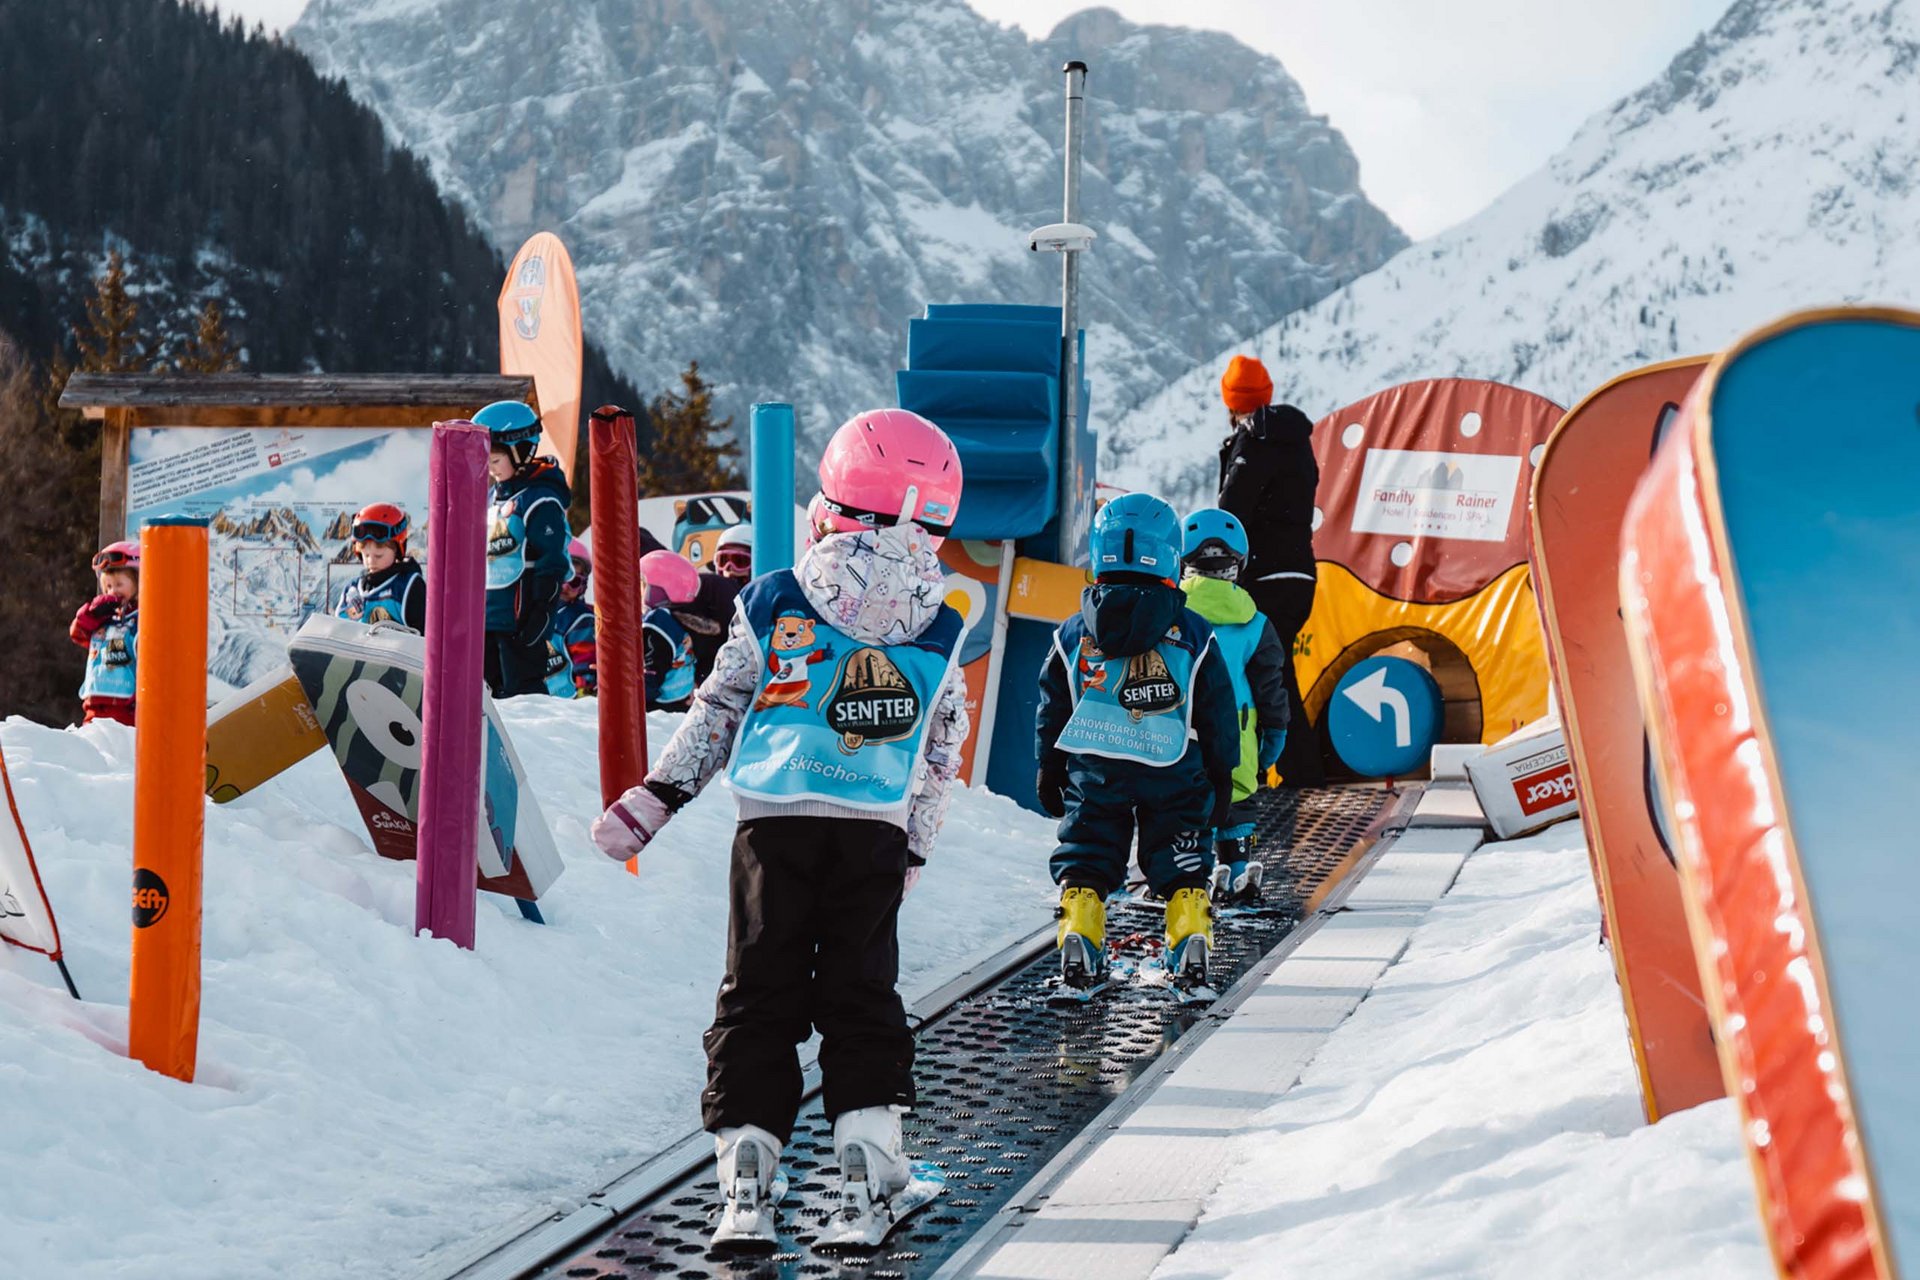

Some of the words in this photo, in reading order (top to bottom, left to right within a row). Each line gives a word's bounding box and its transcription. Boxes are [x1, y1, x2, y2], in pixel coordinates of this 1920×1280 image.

[1456, 492, 1498, 508] Rainer
[1123, 682, 1176, 702] SENFTER
[835, 697, 914, 725] SENFTER
[1062, 727, 1105, 743] SEXTNER
[1107, 734, 1165, 755] DOLOMITEN
[1073, 716, 1137, 737] SNOWBOARD
[1139, 730, 1175, 745] SCHOOL
[1514, 748, 1568, 773] STICCERIA
[1526, 772, 1577, 805] cker
